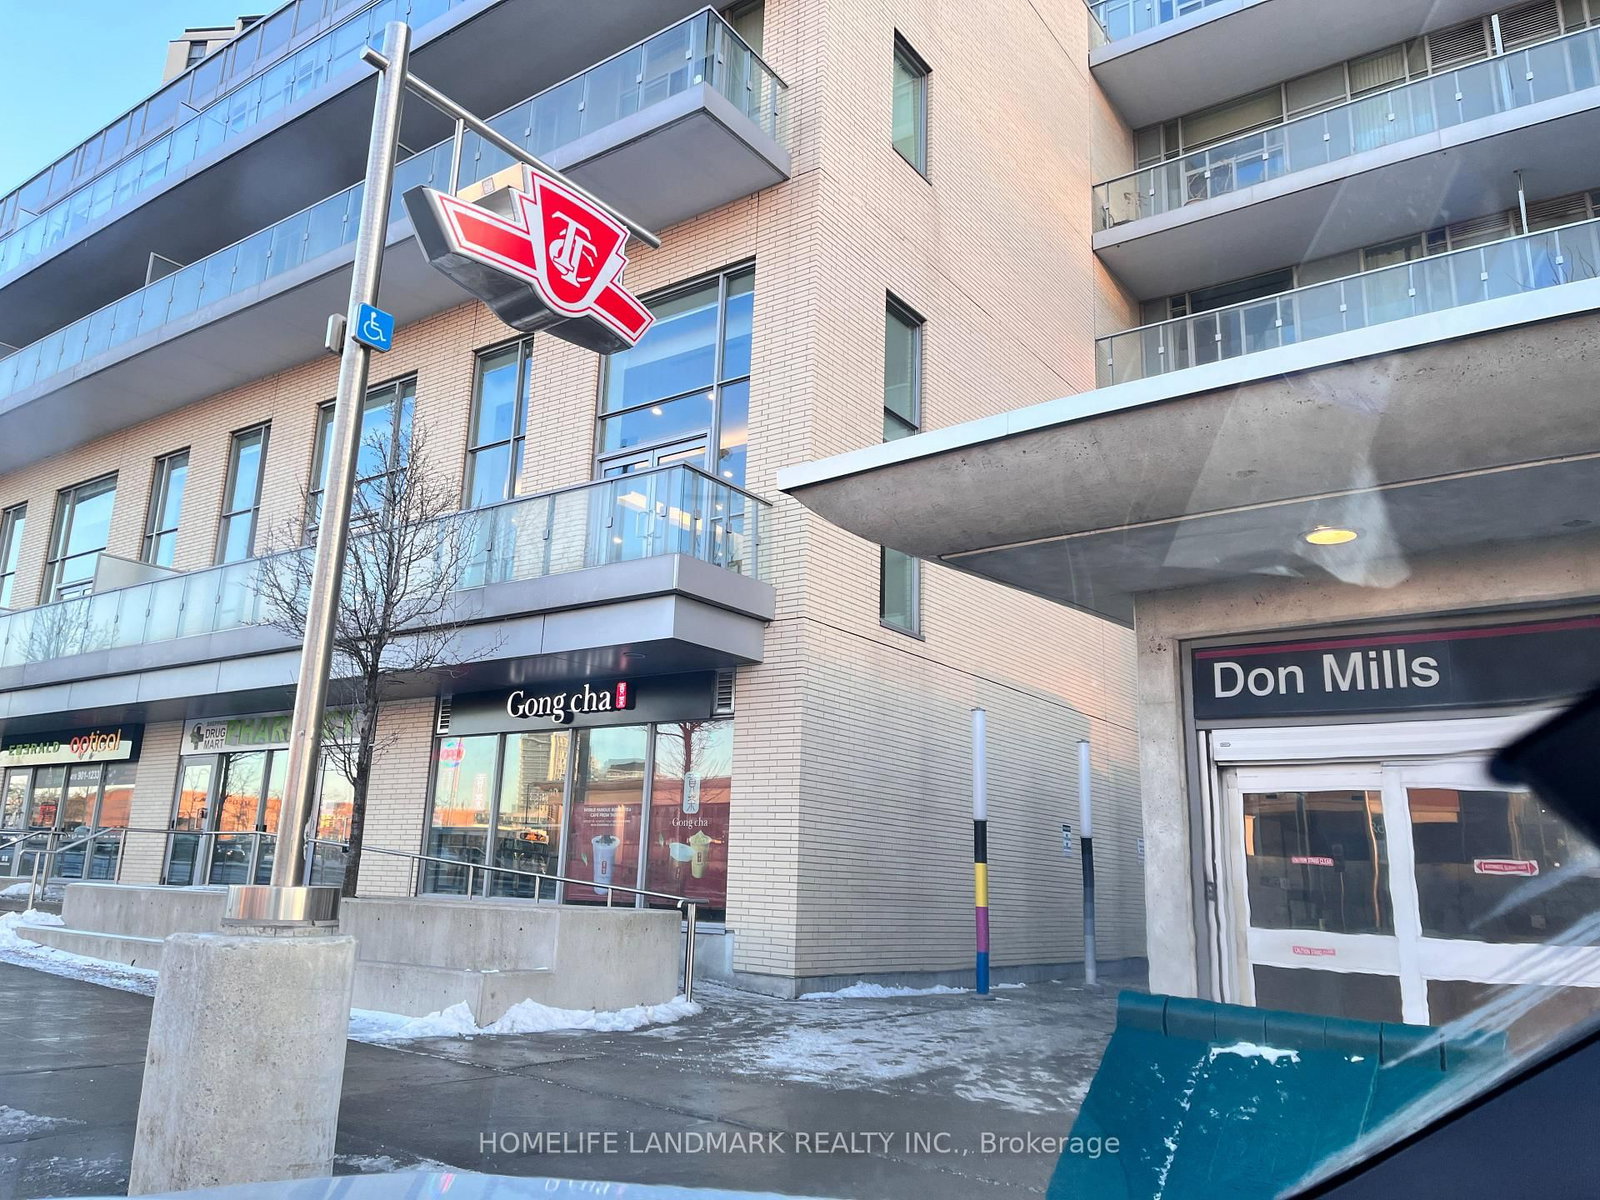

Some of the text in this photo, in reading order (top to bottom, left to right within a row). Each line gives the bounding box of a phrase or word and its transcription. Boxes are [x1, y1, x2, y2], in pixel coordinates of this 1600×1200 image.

[1213, 648, 1440, 698] Don Mills
[507, 683, 612, 723] Gong cha
[205, 727, 226, 738] DRUG
[69, 729, 121, 760] optical
[203, 739, 225, 750] MART
[672, 817, 708, 829] Gong cha
